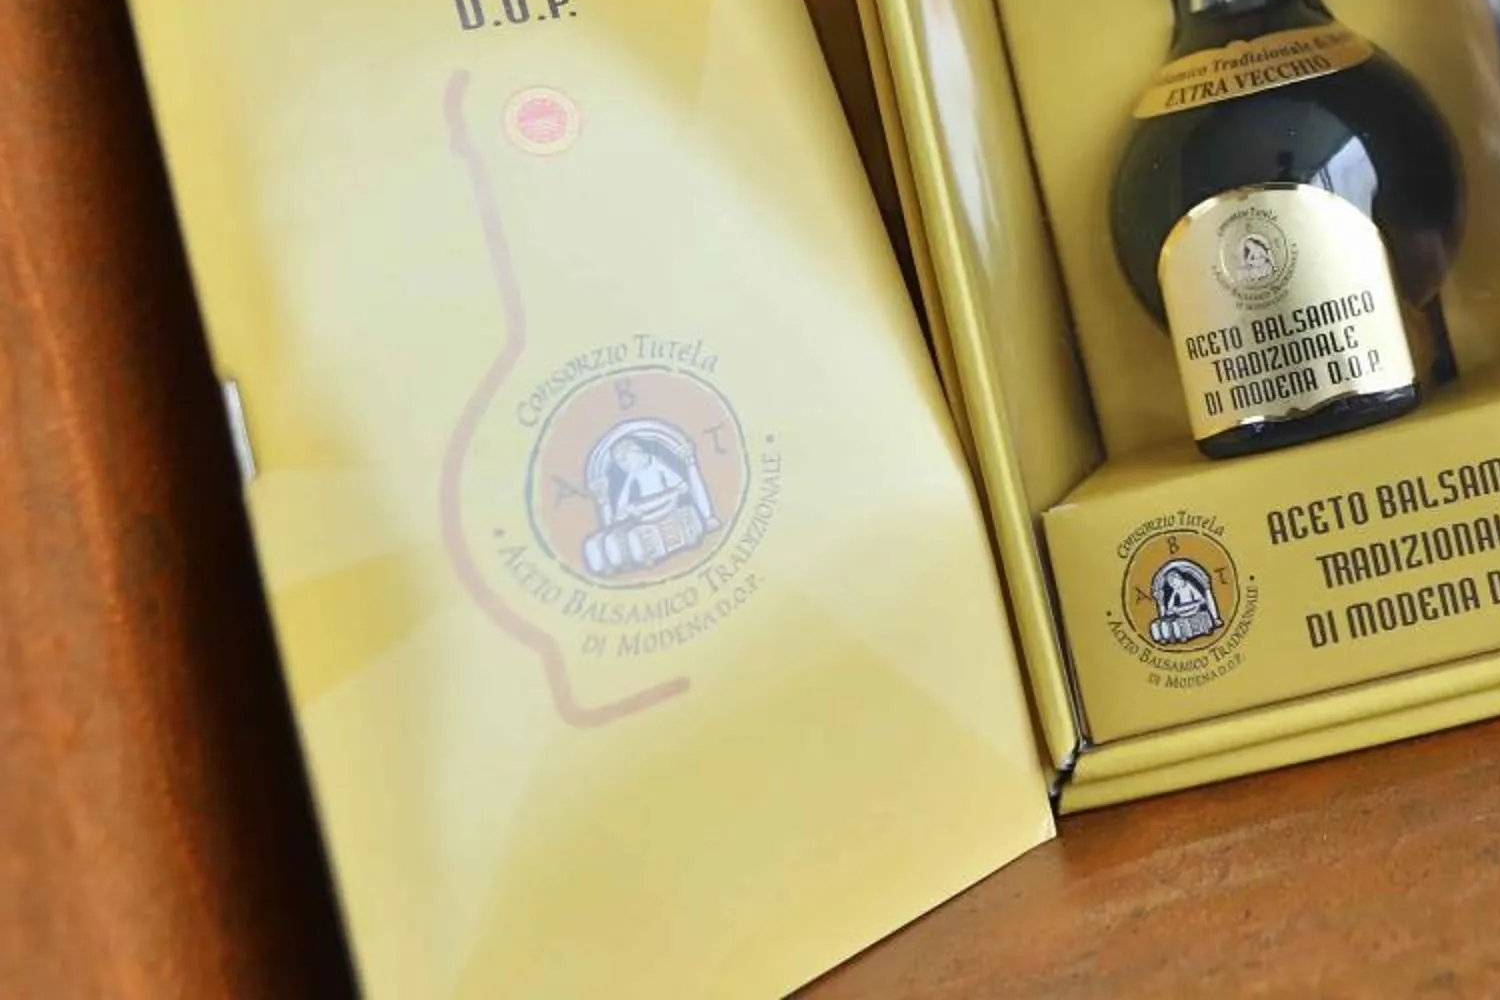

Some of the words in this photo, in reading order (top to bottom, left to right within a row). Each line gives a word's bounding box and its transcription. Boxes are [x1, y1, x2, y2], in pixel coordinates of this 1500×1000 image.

[1165, 76, 1229, 107] EXTRA
[1234, 54, 1332, 88] VECCHIO
[1185, 326, 1243, 361] ACETO
[1252, 290, 1375, 344] BALSAMICO
[1212, 325, 1359, 384] TRADIZIONALE
[1204, 391, 1223, 416] DI
[1231, 368, 1318, 410] MODENA
[1327, 349, 1384, 385] D.O.P.
[1267, 491, 1369, 545] ACETO
[1306, 610, 1339, 648] DI
[1346, 577, 1480, 639] MODENA
